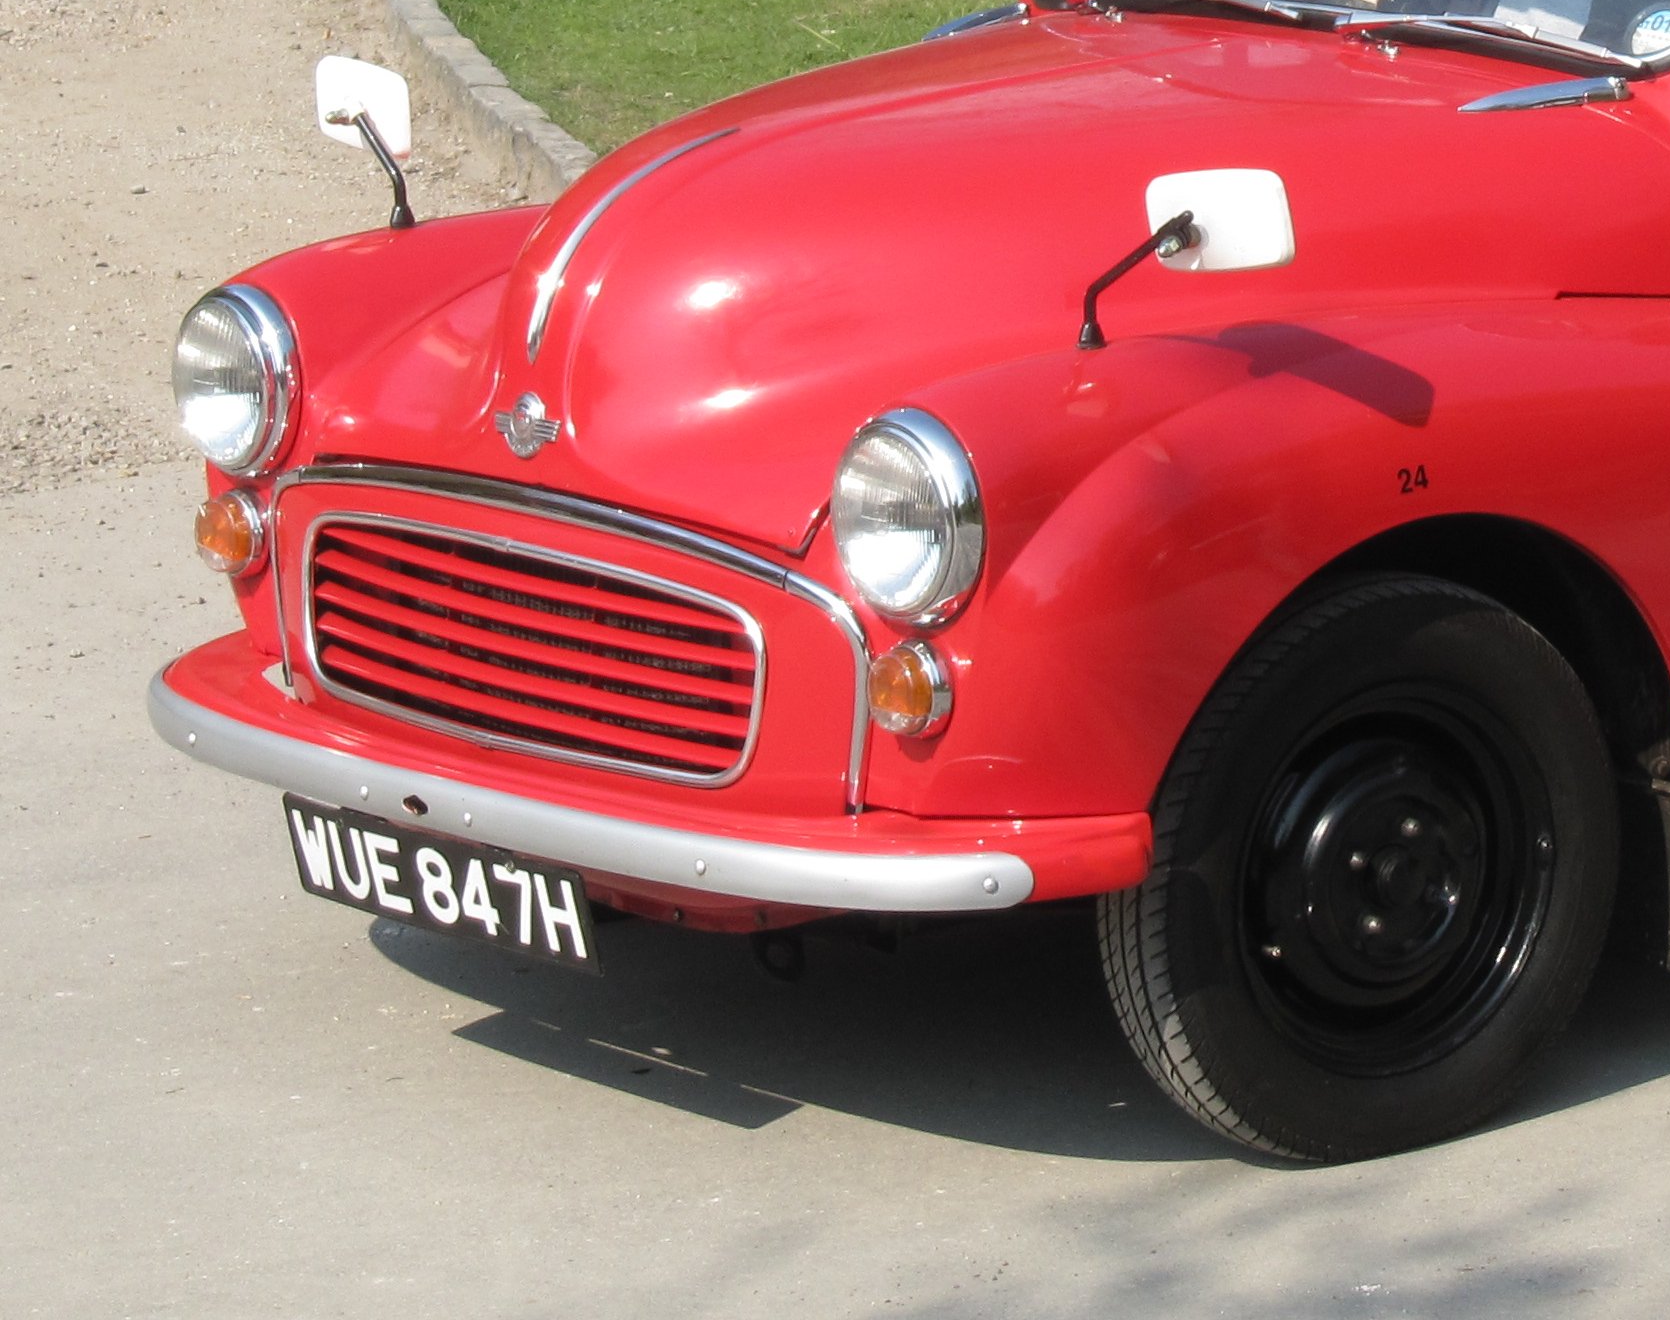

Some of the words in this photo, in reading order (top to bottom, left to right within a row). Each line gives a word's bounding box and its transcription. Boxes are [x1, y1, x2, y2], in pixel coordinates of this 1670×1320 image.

[1396, 464, 1429, 494] 24
[290, 807, 415, 914] WUE
[414, 845, 589, 960] 847H
